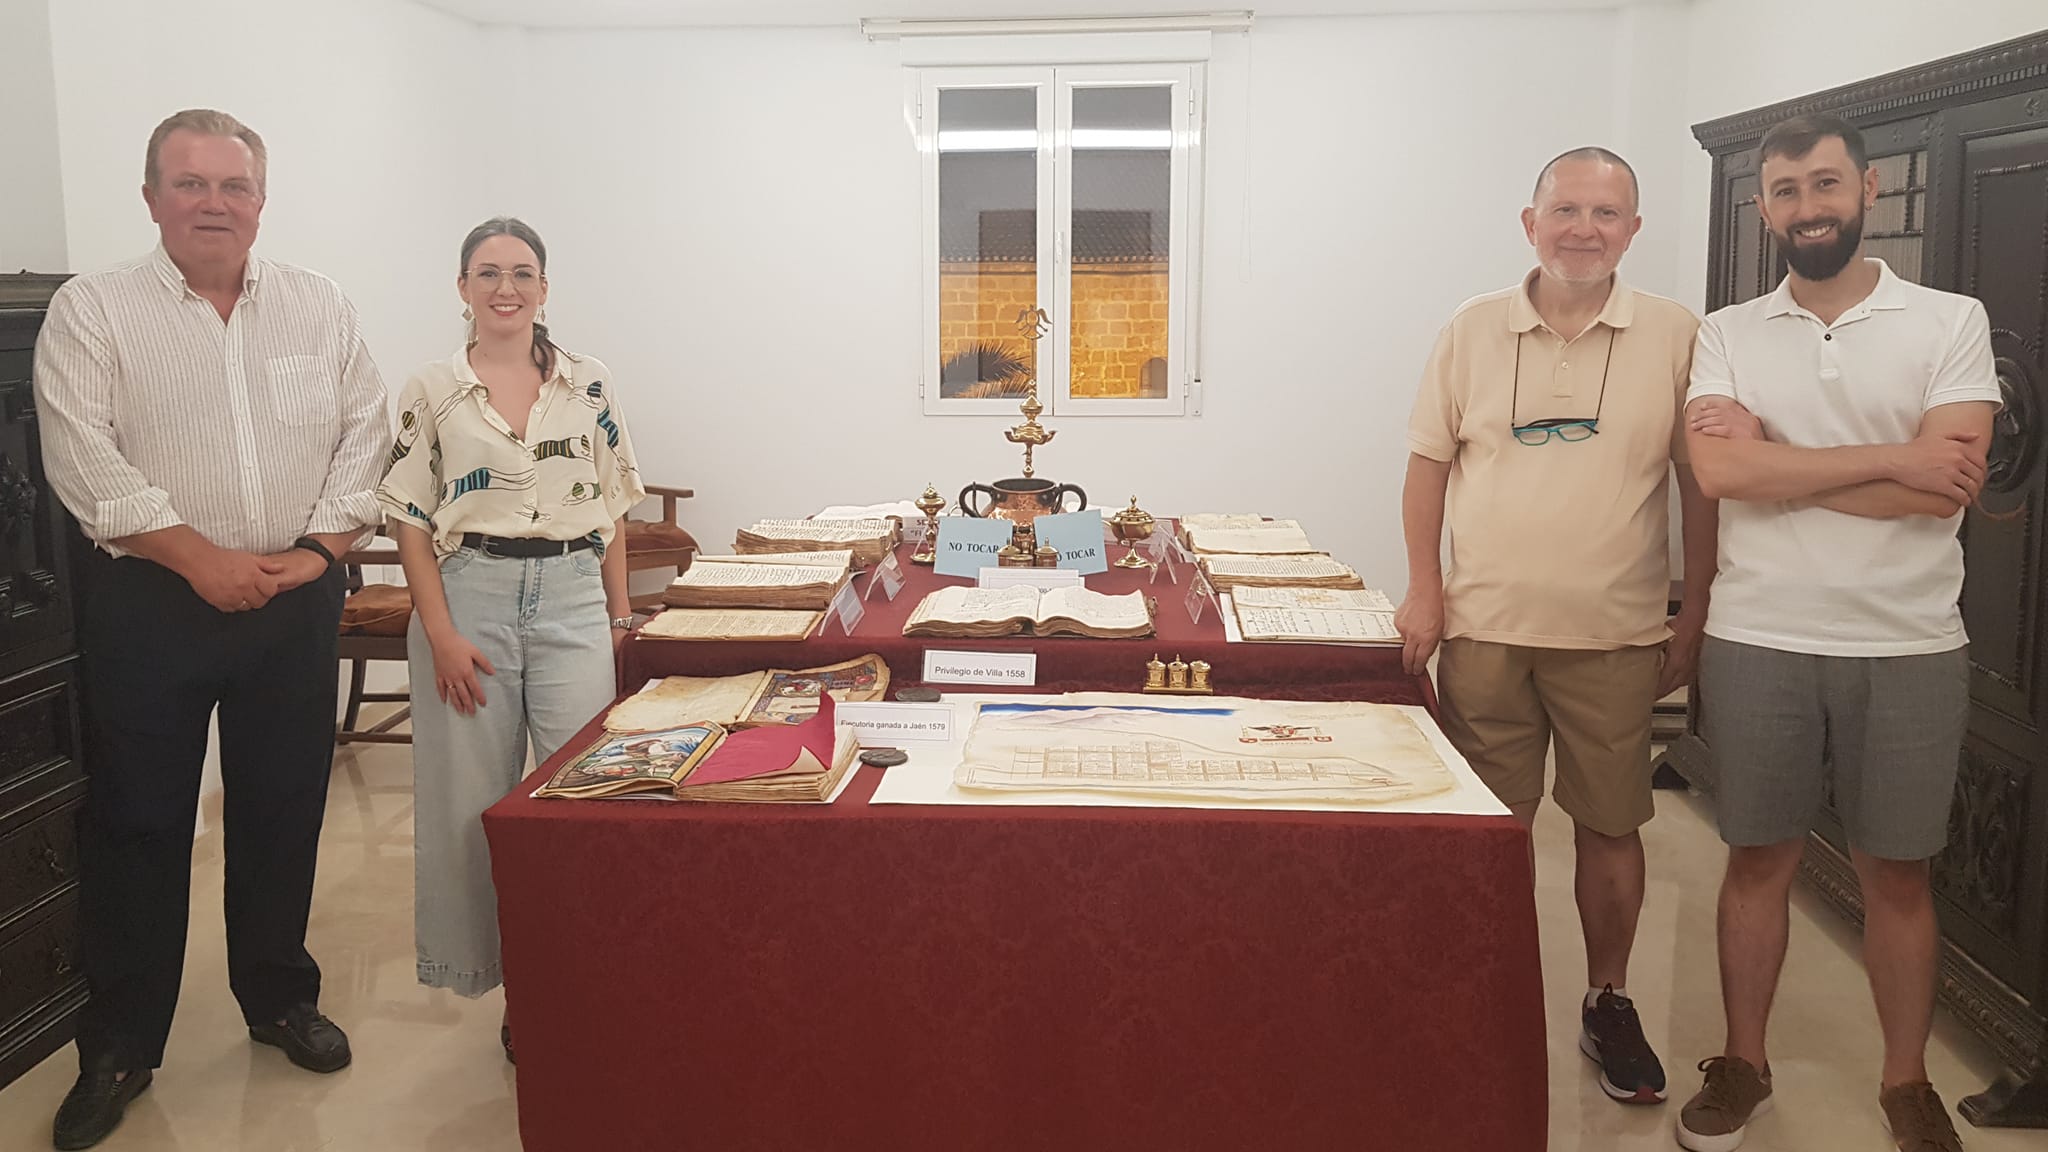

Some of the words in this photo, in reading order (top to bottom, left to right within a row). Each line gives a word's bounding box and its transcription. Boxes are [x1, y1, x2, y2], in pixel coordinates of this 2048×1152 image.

[948, 542, 963, 552] NO
[966, 543, 999, 554] TOCAR
[1066, 549, 1095, 560] TOCAR
[935, 667, 971, 677] Privilegio
[973, 668, 984, 676] de
[986, 669, 1003, 677] Villa
[1006, 670, 1026, 678] 1558
[876, 722, 902, 731] ganada
[909, 722, 926, 730] Jaén
[928, 723, 946, 731] 1579
